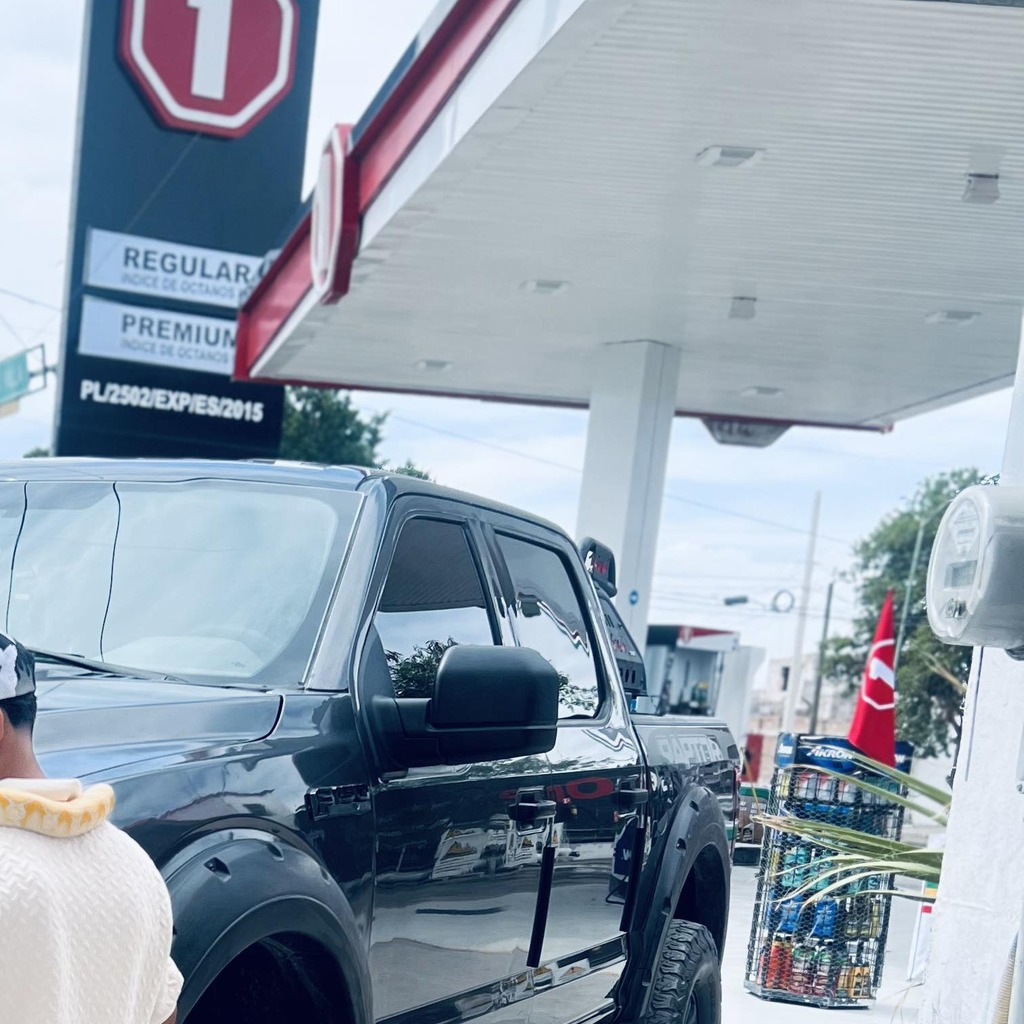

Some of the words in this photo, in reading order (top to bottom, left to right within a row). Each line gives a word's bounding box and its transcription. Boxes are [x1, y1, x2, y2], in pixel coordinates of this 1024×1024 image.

[187, 0, 233, 101] 1
[123, 246, 251, 284] REGULAR
[80, 379, 265, 422] PL/2502/EXP/ES/2015
